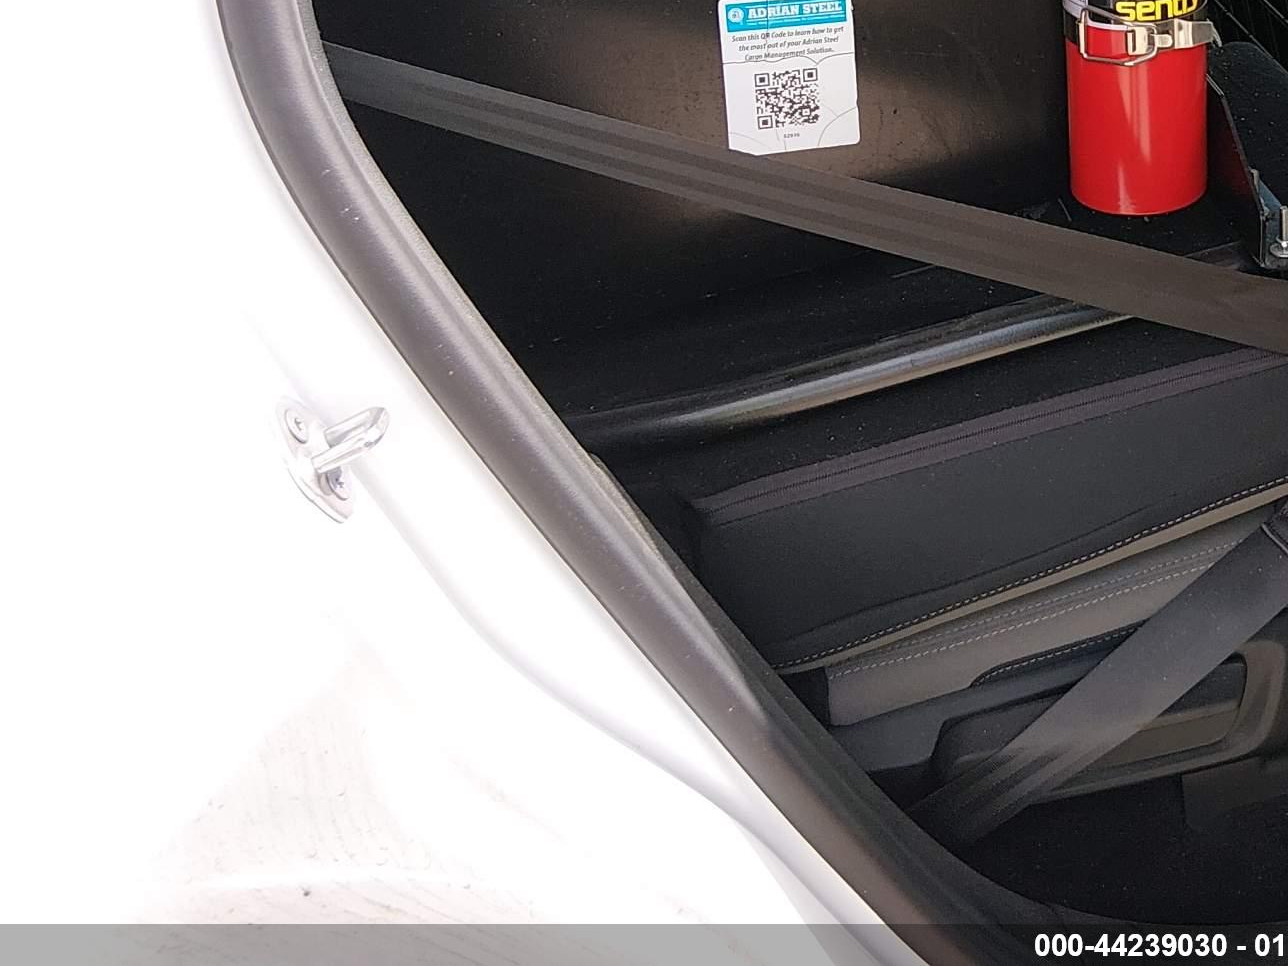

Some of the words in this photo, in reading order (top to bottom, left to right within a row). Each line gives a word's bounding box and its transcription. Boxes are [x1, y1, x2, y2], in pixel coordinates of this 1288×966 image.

[748, 5, 799, 18] ADRIAN
[802, 0, 843, 14] STEEL
[812, 27, 825, 35] how
[834, 26, 844, 34] get
[780, 40, 787, 48] of
[787, 39, 802, 48] your
[802, 37, 822, 45] Adrian
[745, 53, 763, 63] Cargo
[764, 49, 805, 60] Management
[806, 46, 835, 54] Solution.
